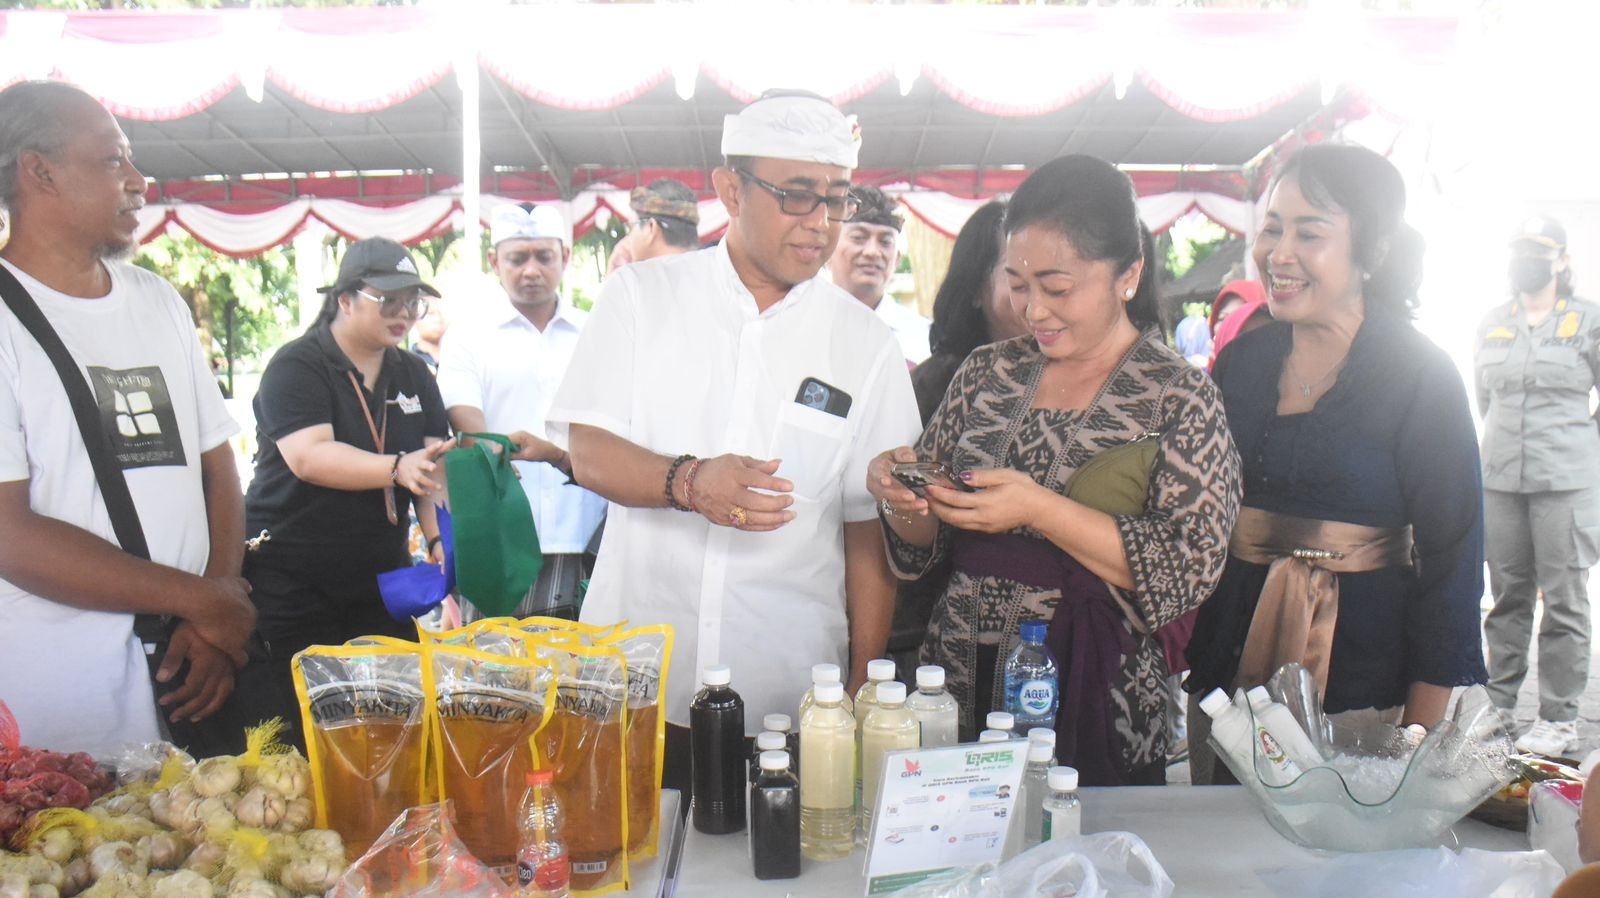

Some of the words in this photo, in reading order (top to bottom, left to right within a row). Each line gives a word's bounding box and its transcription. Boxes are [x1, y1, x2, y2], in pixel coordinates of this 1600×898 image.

[1023, 689, 1050, 700] AQUA
[438, 700, 528, 724] MINYAKA
[966, 751, 1014, 766] QRIS
[901, 769, 922, 778] GPN
